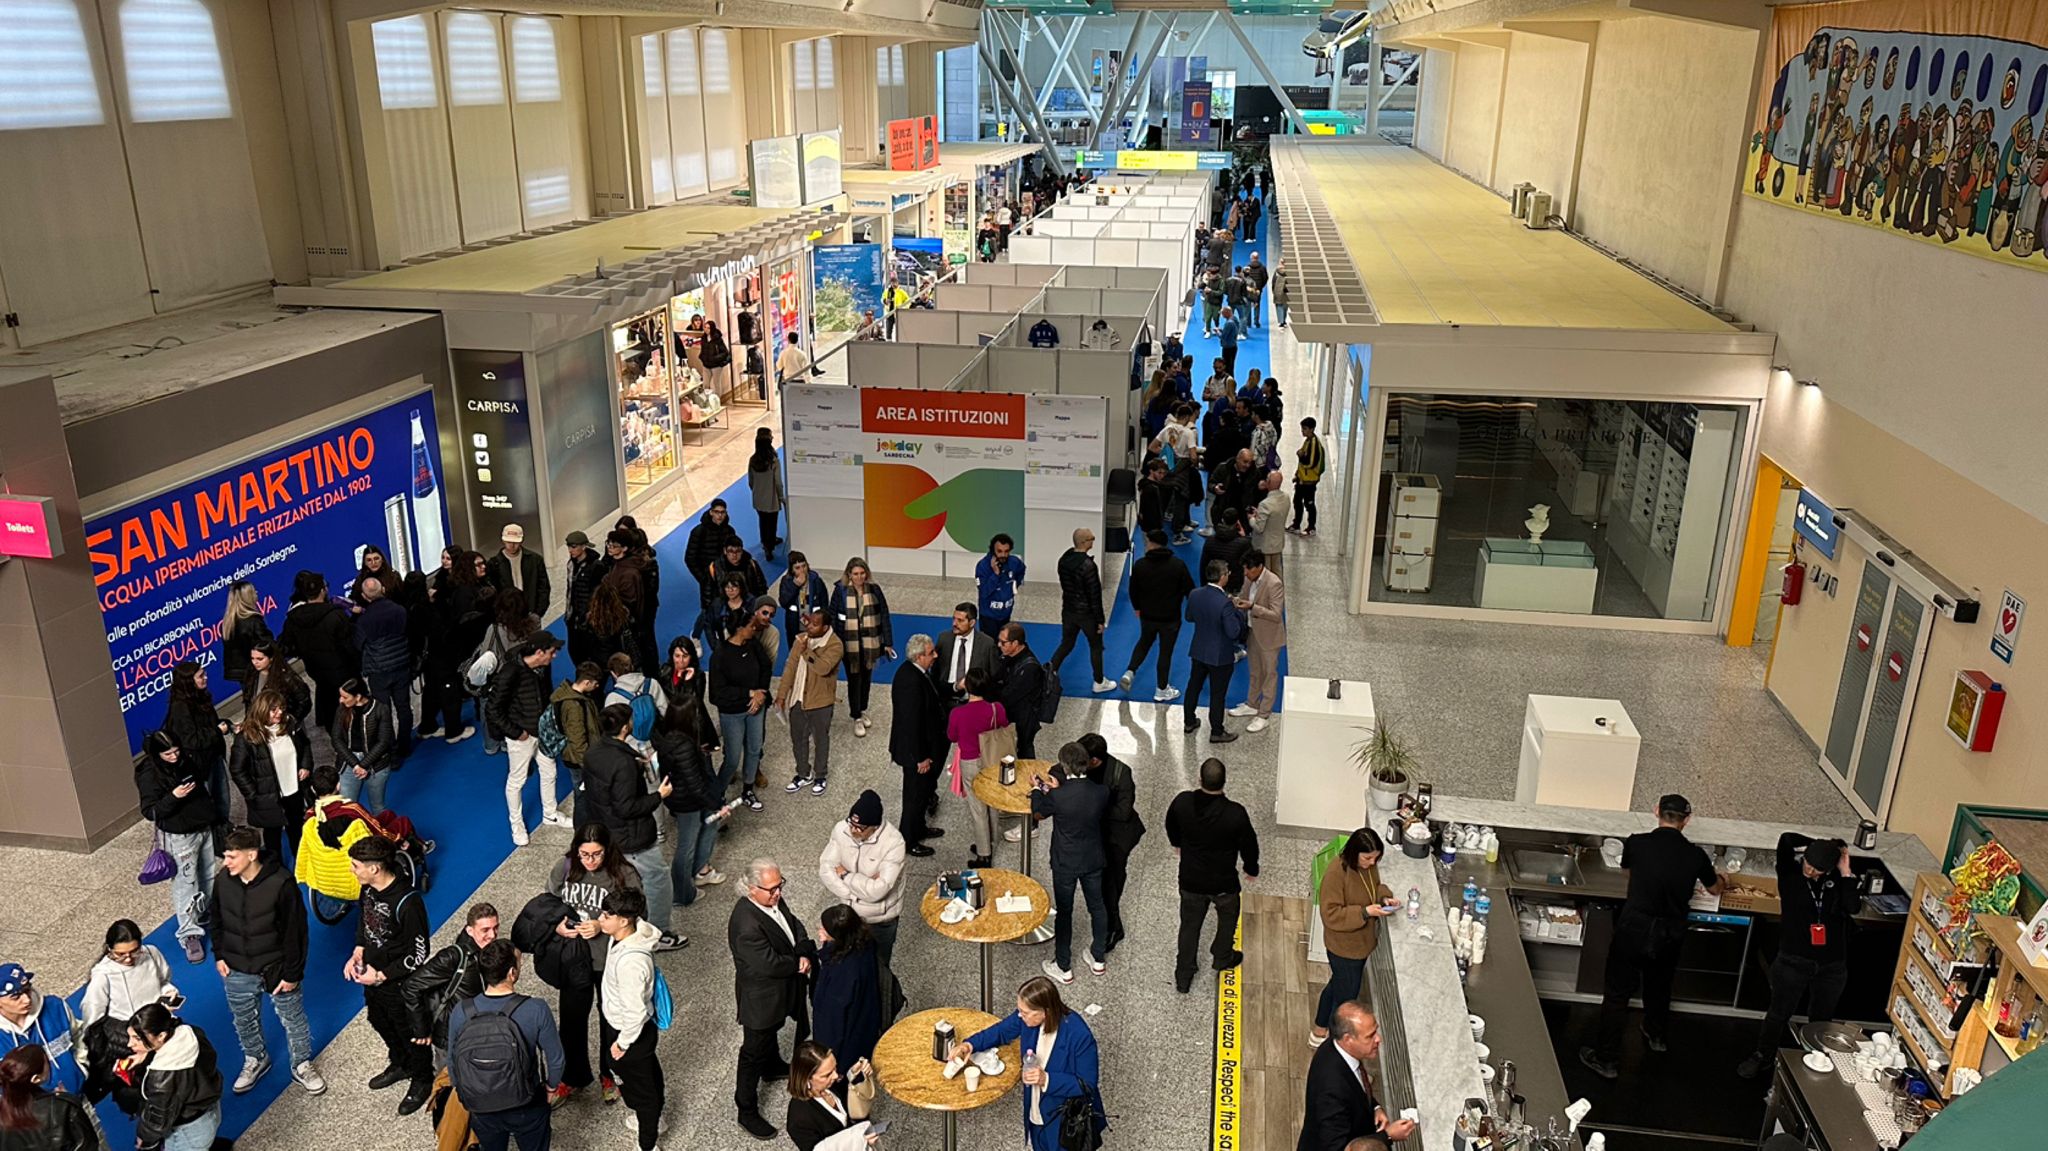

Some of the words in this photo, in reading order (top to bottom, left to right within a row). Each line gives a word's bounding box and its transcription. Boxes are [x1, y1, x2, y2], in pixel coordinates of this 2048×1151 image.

[467, 399, 520, 414] CARPISA
[876, 406, 918, 421] AREA
[921, 408, 1009, 426] ISTITUZIONI
[5, 522, 35, 533] Toilets
[86, 500, 188, 586] SAN
[194, 427, 375, 540] MARTINO
[155, 527, 257, 588] IPERMINERALE
[257, 496, 323, 540] FRIZZANTE
[323, 486, 348, 509] DAL
[347, 473, 372, 497] 1902
[129, 597, 184, 636] profondità
[183, 574, 233, 604] vulcaniche
[233, 561, 256, 580] della
[255, 543, 299, 570] Sardegna.
[2005, 596, 2021, 613] DAE
[133, 648, 145, 661] DI
[145, 617, 204, 652] BICARBONATI,
[122, 636, 200, 690] L'ACQUA
[1222, 1001, 1238, 1049] sicurezza
[1220, 1110, 1237, 1132] the
